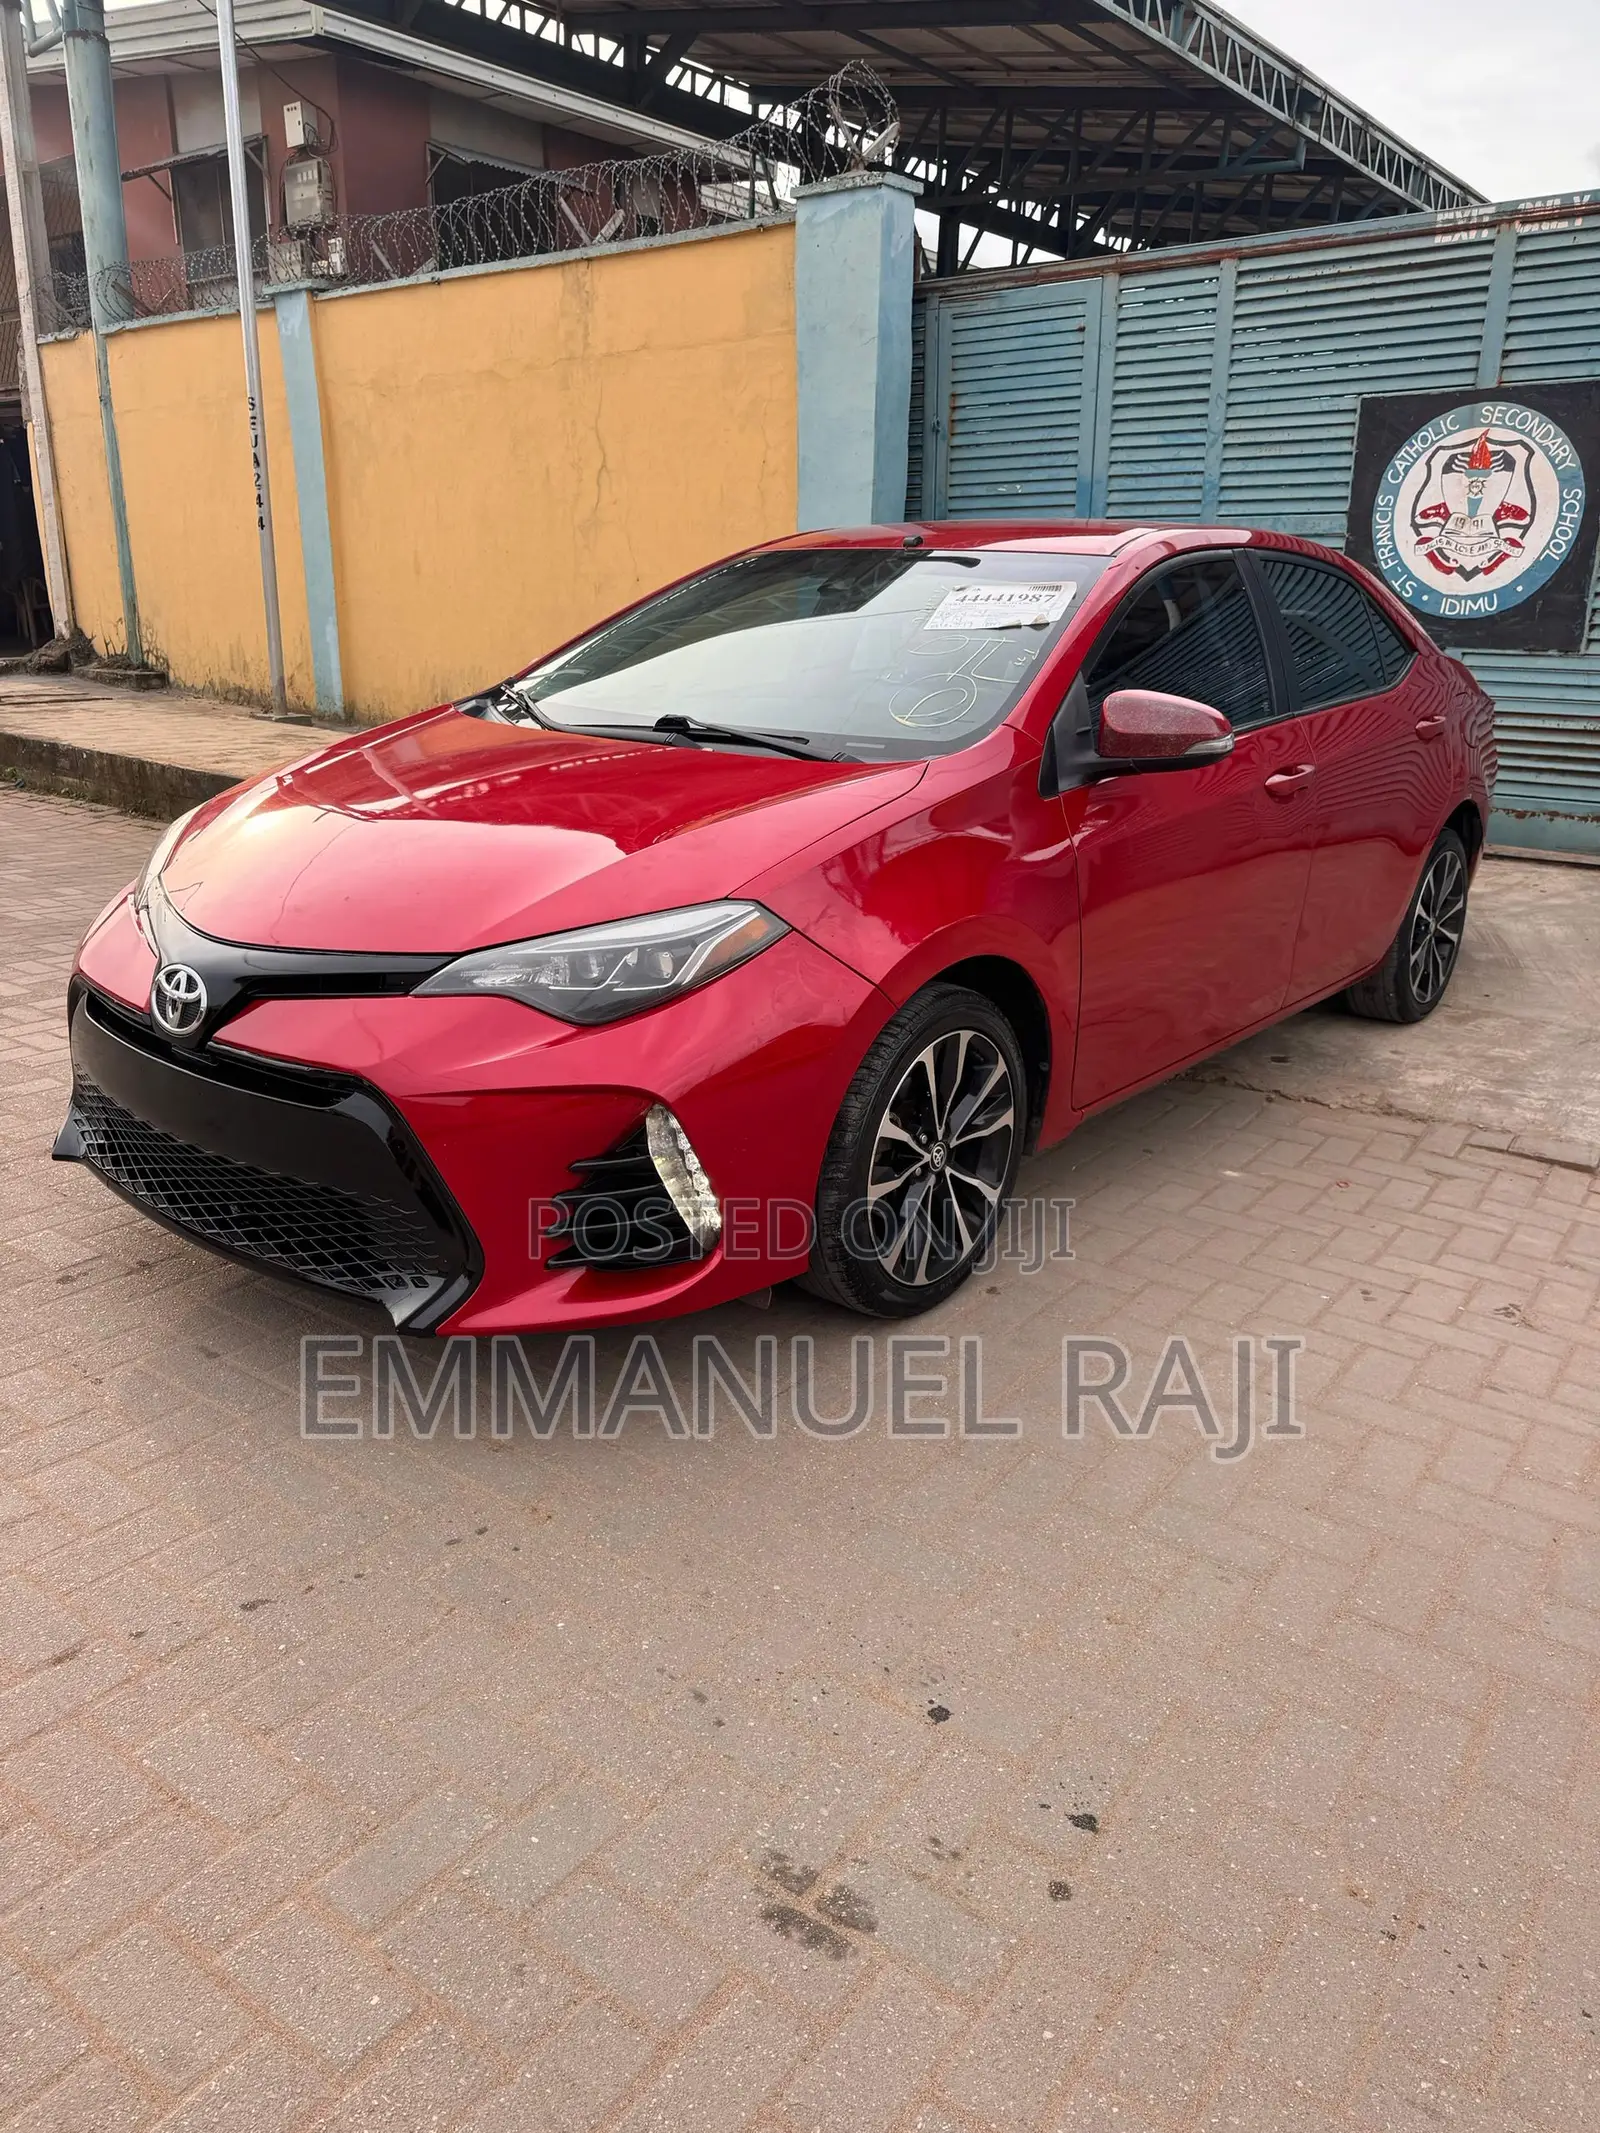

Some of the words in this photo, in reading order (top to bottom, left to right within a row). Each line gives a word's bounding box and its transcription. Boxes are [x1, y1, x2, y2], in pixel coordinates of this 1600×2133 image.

[1387, 414, 1460, 484] CATHOLIC
[1480, 405, 1576, 471] SECONDARY
[1539, 488, 1583, 561] SCHOOL
[955, 593, 1056, 604] 44441987
[1440, 593, 1498, 616] IDIMU
